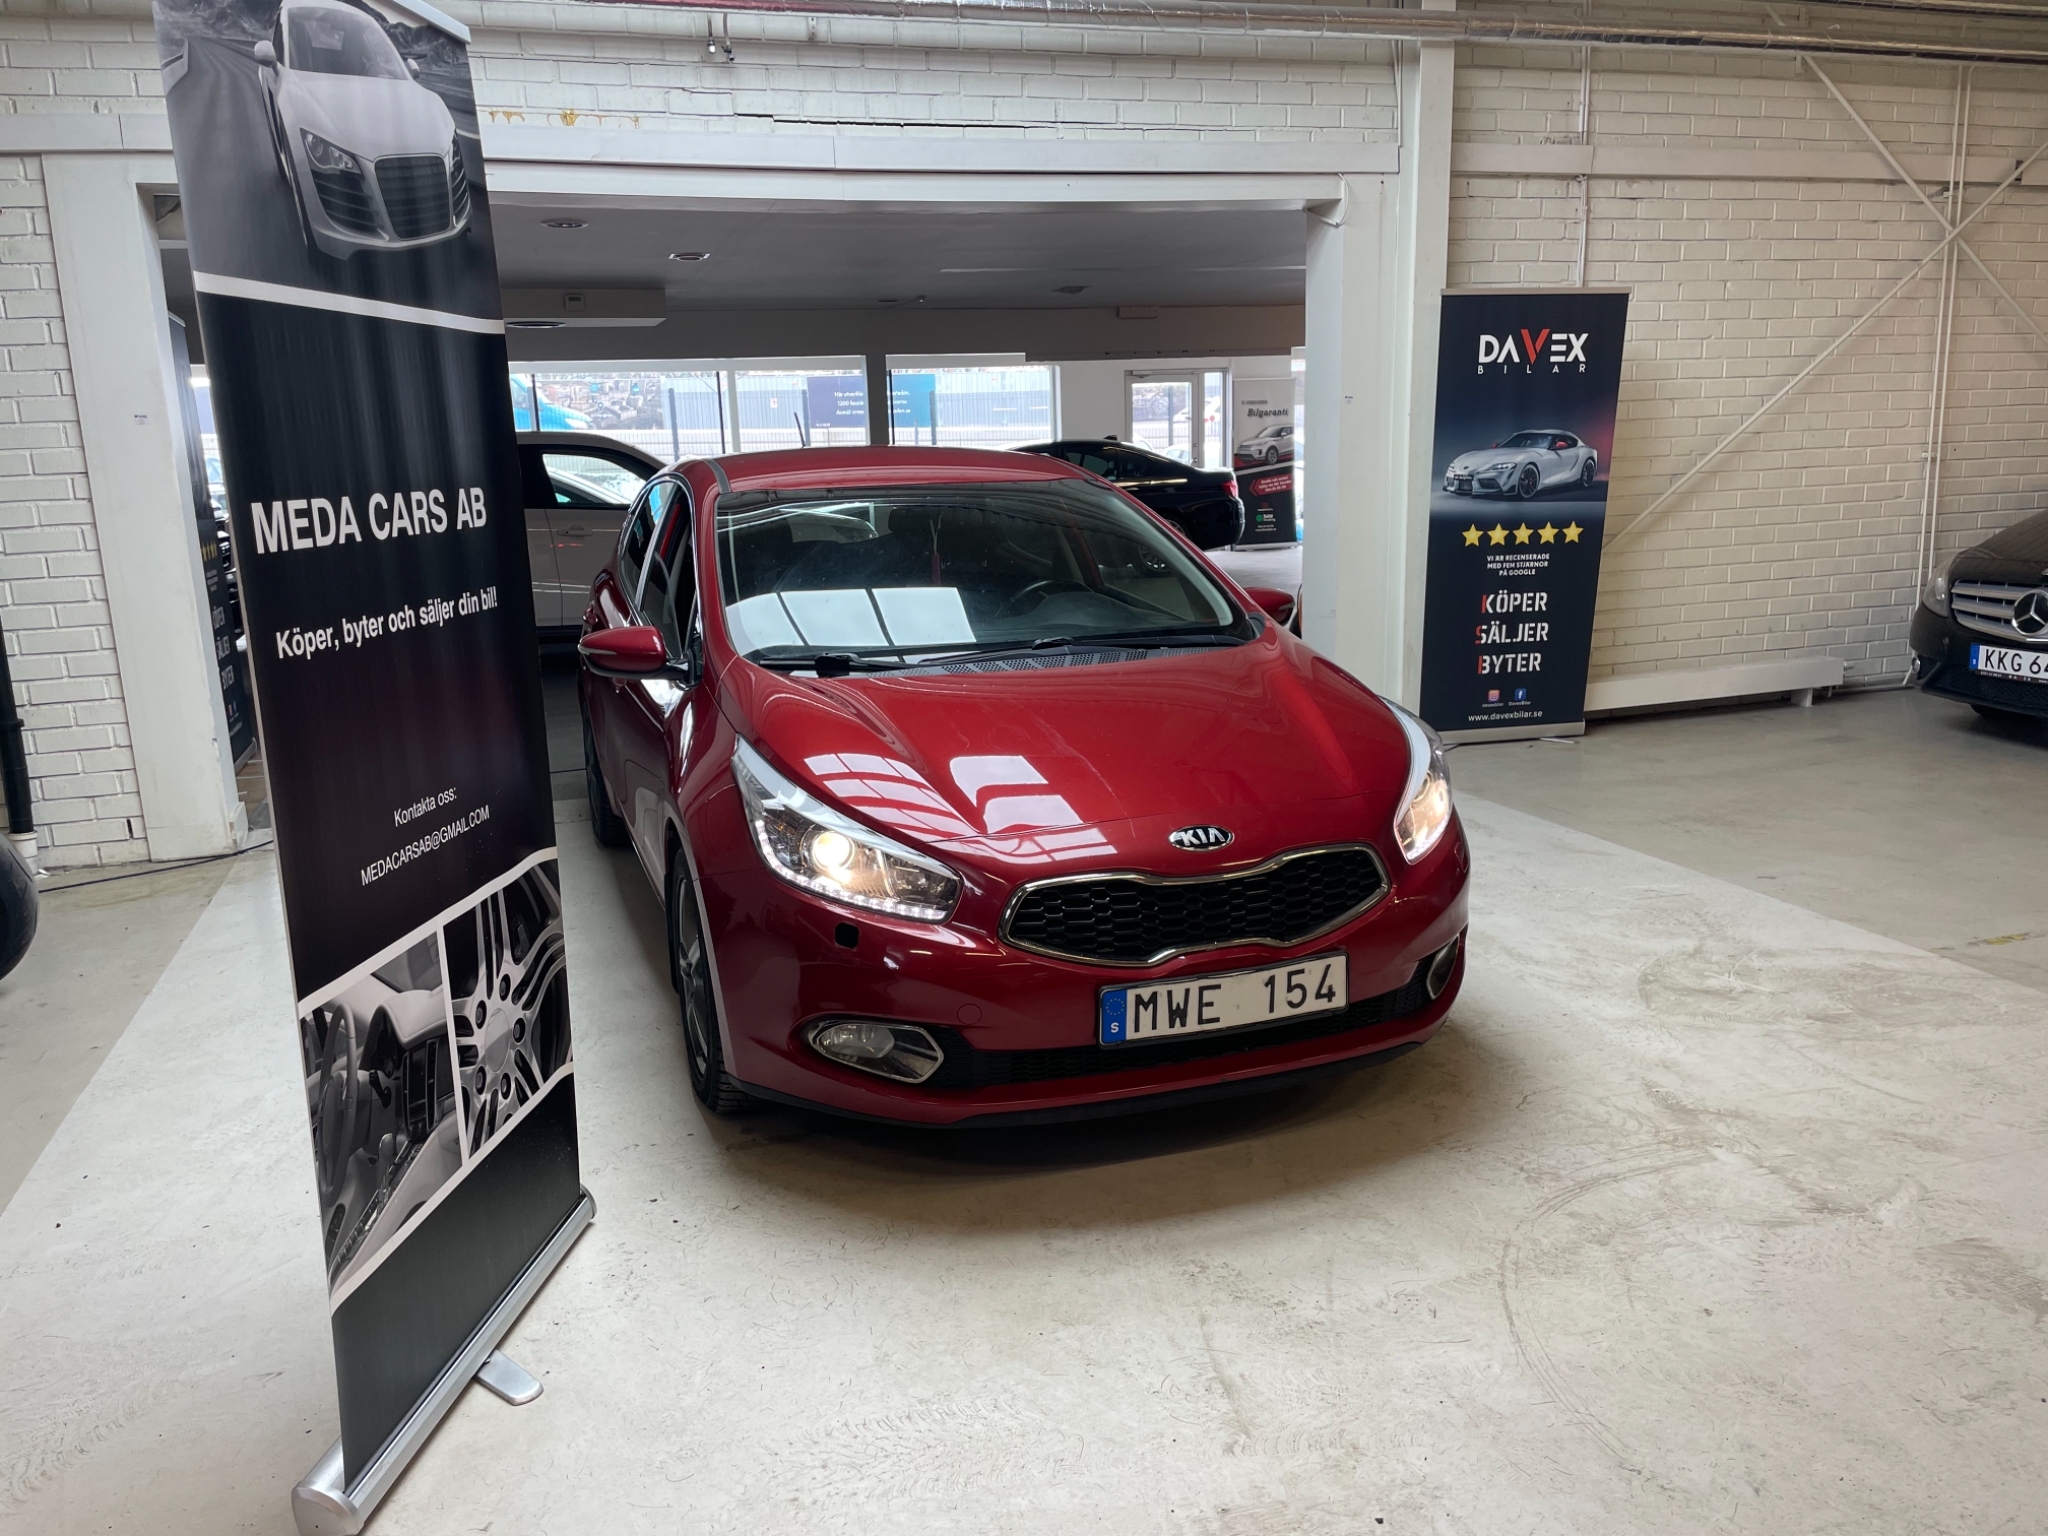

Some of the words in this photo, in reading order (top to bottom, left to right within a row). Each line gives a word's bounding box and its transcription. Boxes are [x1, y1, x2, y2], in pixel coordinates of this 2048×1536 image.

[1478, 328, 1589, 365] DAVEX
[1477, 363, 1586, 375] BILAR
[1247, 407, 1289, 419] Bilgaranti
[251, 496, 362, 554] MEDA
[368, 489, 448, 540] CARS
[456, 487, 487, 530] AB
[1505, 553, 1550, 561] RECENSERADE
[1516, 560, 1549, 568] STJÄRNOR
[1499, 568, 1508, 576] PÅ
[1508, 568, 1536, 576] GOOGLE
[1481, 589, 1548, 613] KÖPER
[276, 627, 340, 660] Köper,
[341, 615, 384, 648] byter
[388, 605, 416, 632] och
[419, 598, 454, 627] säljer
[458, 591, 480, 616] din
[480, 586, 498, 609] bil!
[1475, 620, 1549, 644] SÄLJER
[1477, 652, 1542, 674] BYTER
[1984, 648, 2023, 673] KKG
[1468, 710, 1543, 721] www.davexbilar.se
[394, 796, 436, 827] Kontakta
[437, 787, 457, 806] oss:
[360, 804, 490, 886] MEDACARSAB@GMAIL.COM
[1180, 827, 1227, 846] KIA
[1110, 1022, 1119, 1033] S
[1134, 983, 1222, 1033] MWE
[1264, 963, 1336, 1014] 154
